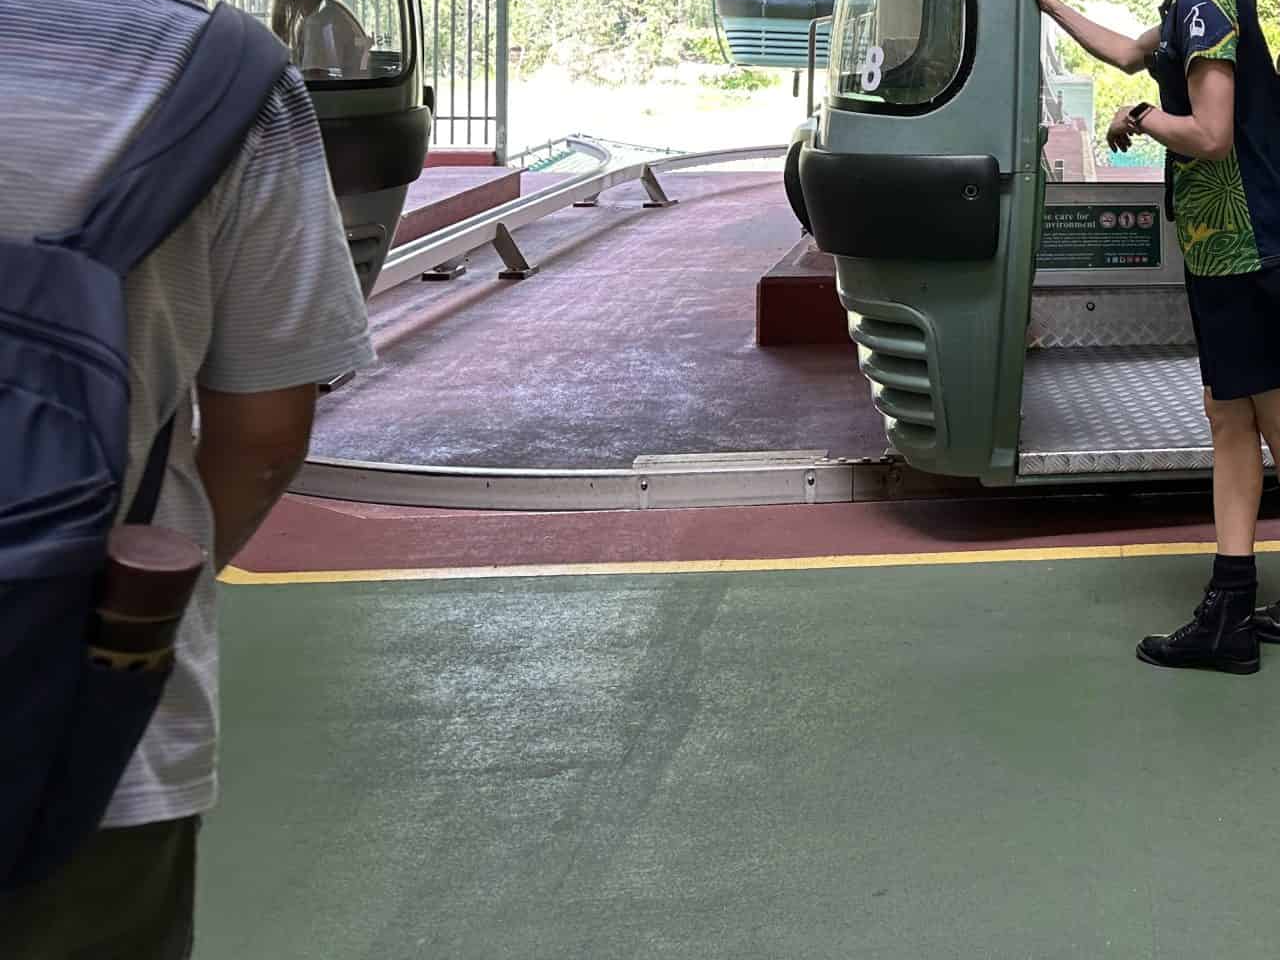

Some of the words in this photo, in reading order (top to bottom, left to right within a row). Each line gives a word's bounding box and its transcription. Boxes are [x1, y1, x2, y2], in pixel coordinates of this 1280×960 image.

[861, 47, 884, 92] 8
[1077, 211, 1089, 220] for
[1046, 220, 1096, 229] nvironment
